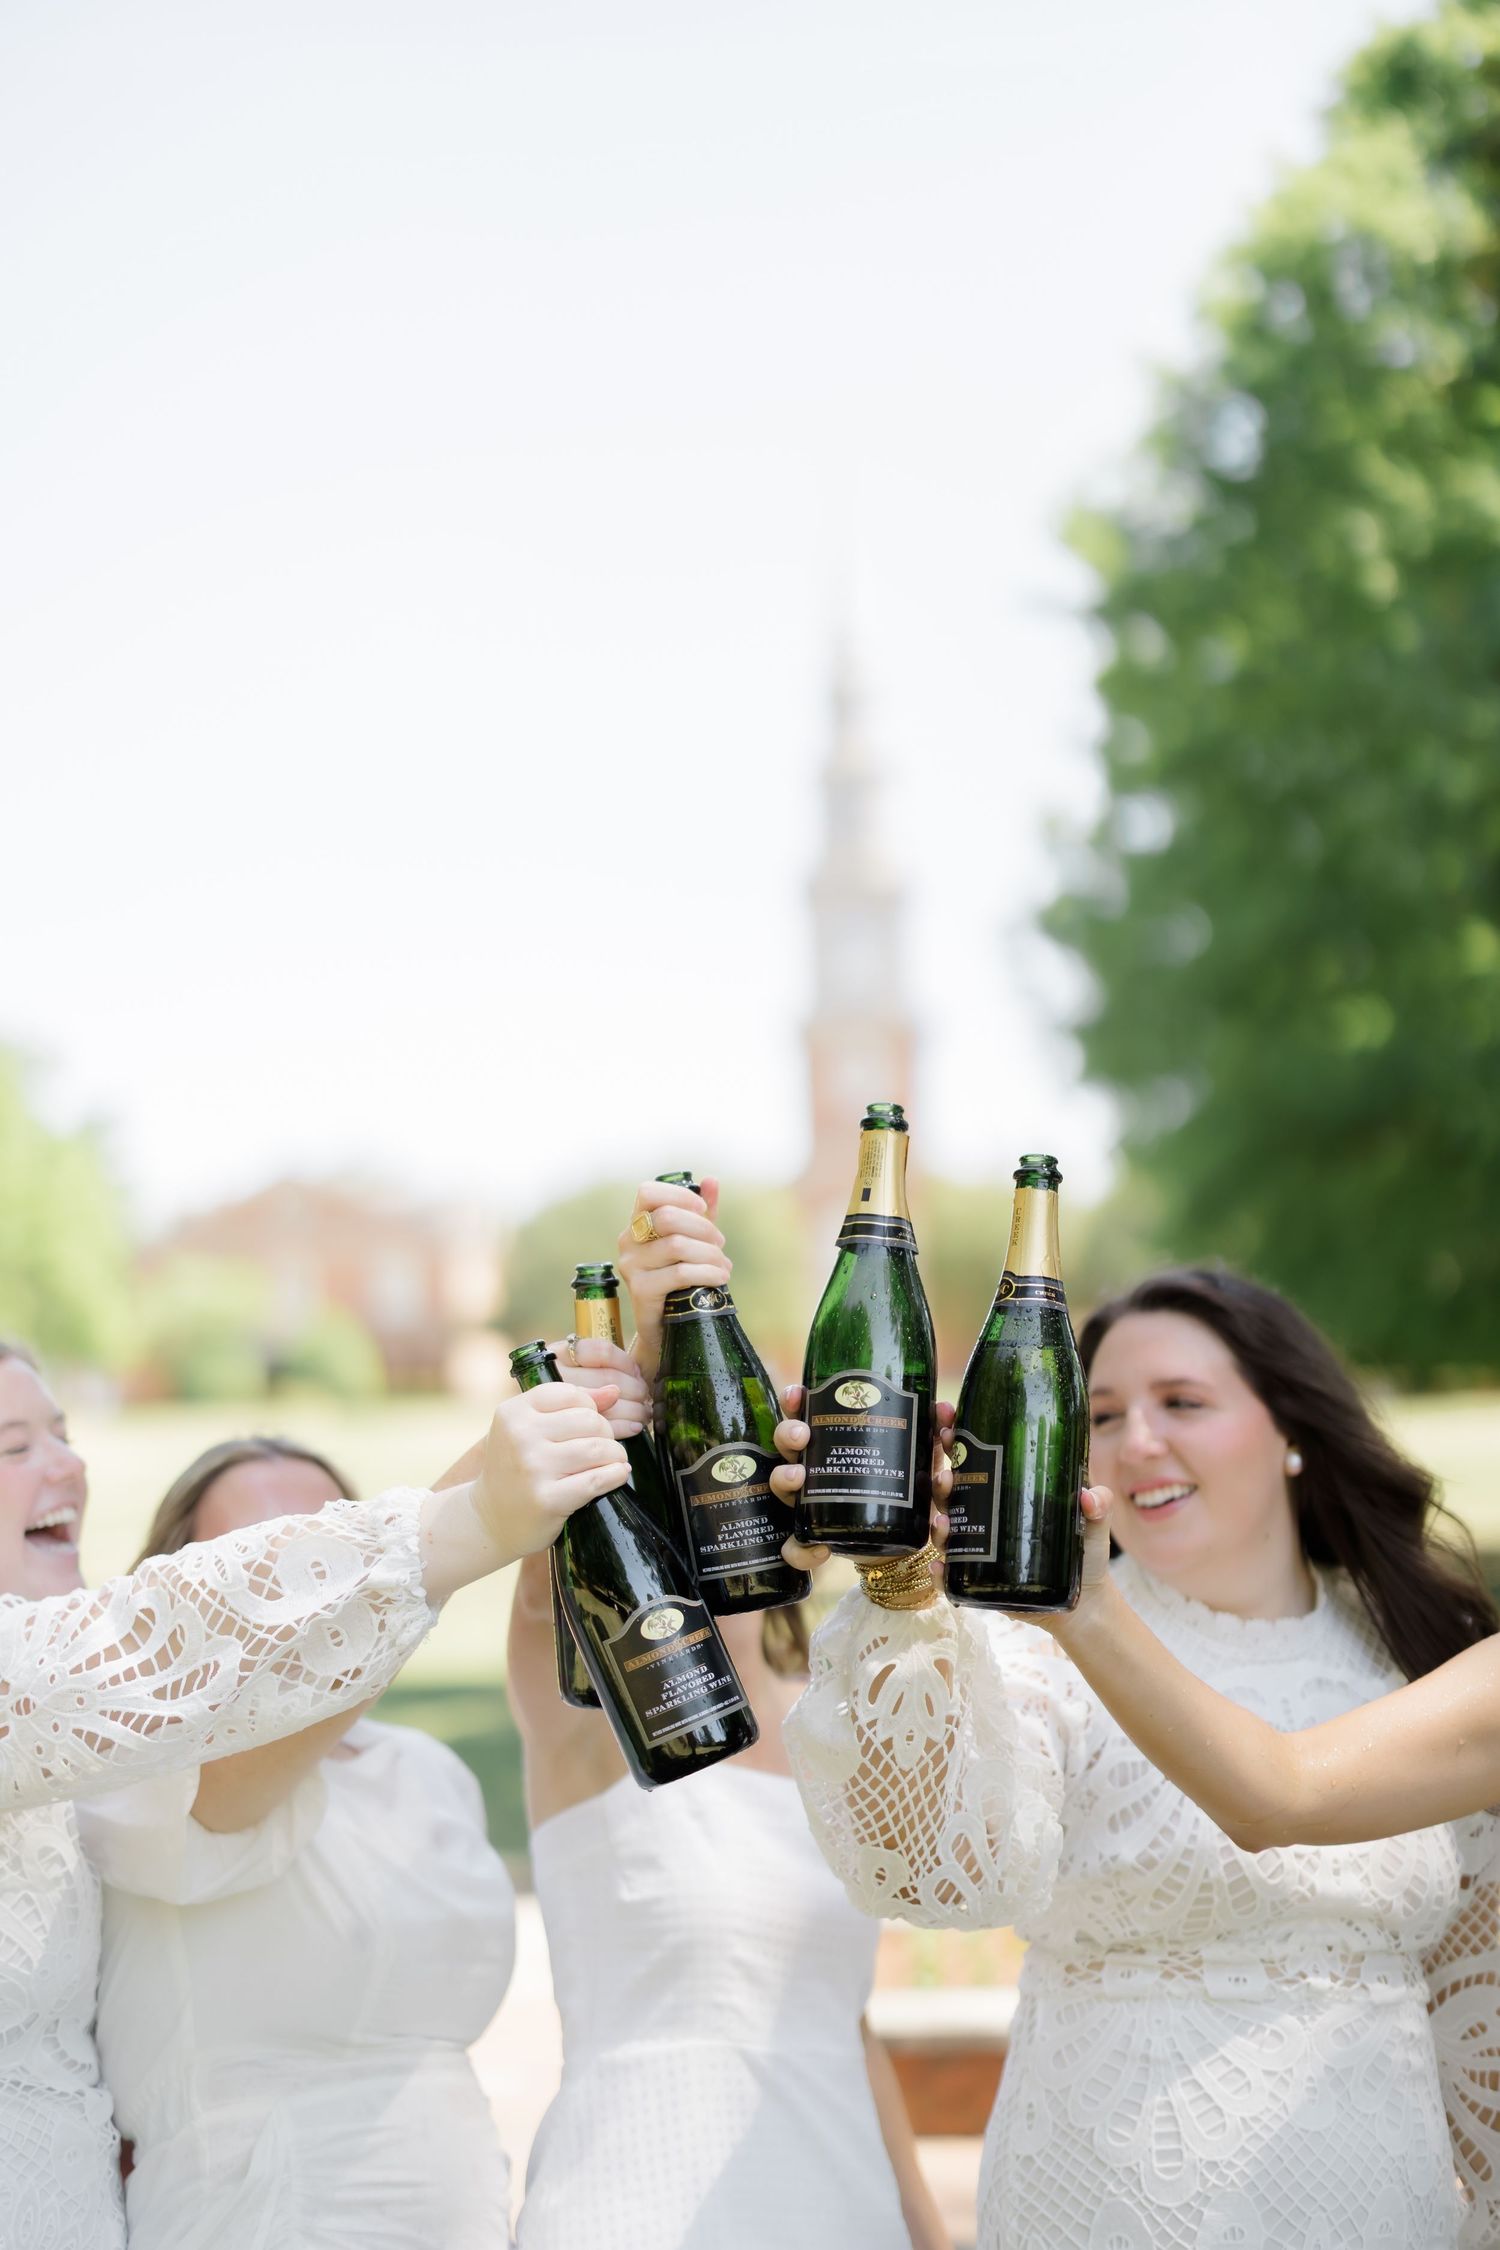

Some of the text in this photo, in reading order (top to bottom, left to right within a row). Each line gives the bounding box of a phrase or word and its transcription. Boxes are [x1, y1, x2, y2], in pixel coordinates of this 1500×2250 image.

[1012, 1207, 1022, 1246] CREEK
[597, 1307, 609, 1338] ALMO
[814, 1415, 905, 1427] ALMOND CREEK
[830, 1448, 880, 1457] ALMOND
[826, 1457, 885, 1466] FLAVORED
[809, 1466, 905, 1478] SPARKLING WINE
[694, 1488, 740, 1505] ALMOND
[721, 1516, 768, 1532] ALMOND
[960, 1525, 985, 1533] WINE
[717, 1525, 774, 1541] FLAVORED
[700, 1536, 763, 1553] SPARKLING
[626, 1628, 711, 1669] ALMOND CREEK
[663, 1665, 708, 1689] ALMOND
[661, 1672, 715, 1700] FLAVORED
[645, 1685, 708, 1718] SPARKLING
[707, 1674, 732, 1689] WINE
